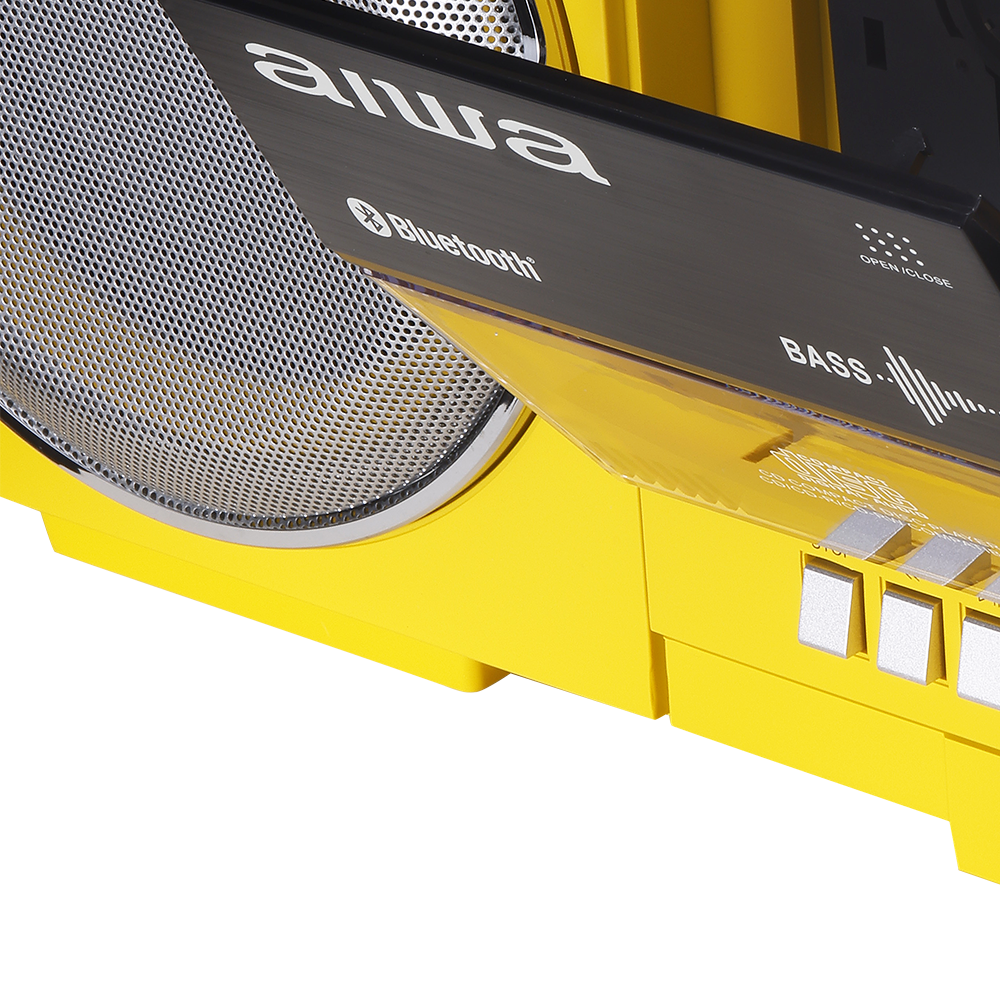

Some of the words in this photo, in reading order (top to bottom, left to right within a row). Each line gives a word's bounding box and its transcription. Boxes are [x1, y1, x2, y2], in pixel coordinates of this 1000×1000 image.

[245, 42, 611, 187] aiwa
[859, 254, 900, 273] OPEN
[779, 335, 873, 385] BASS
